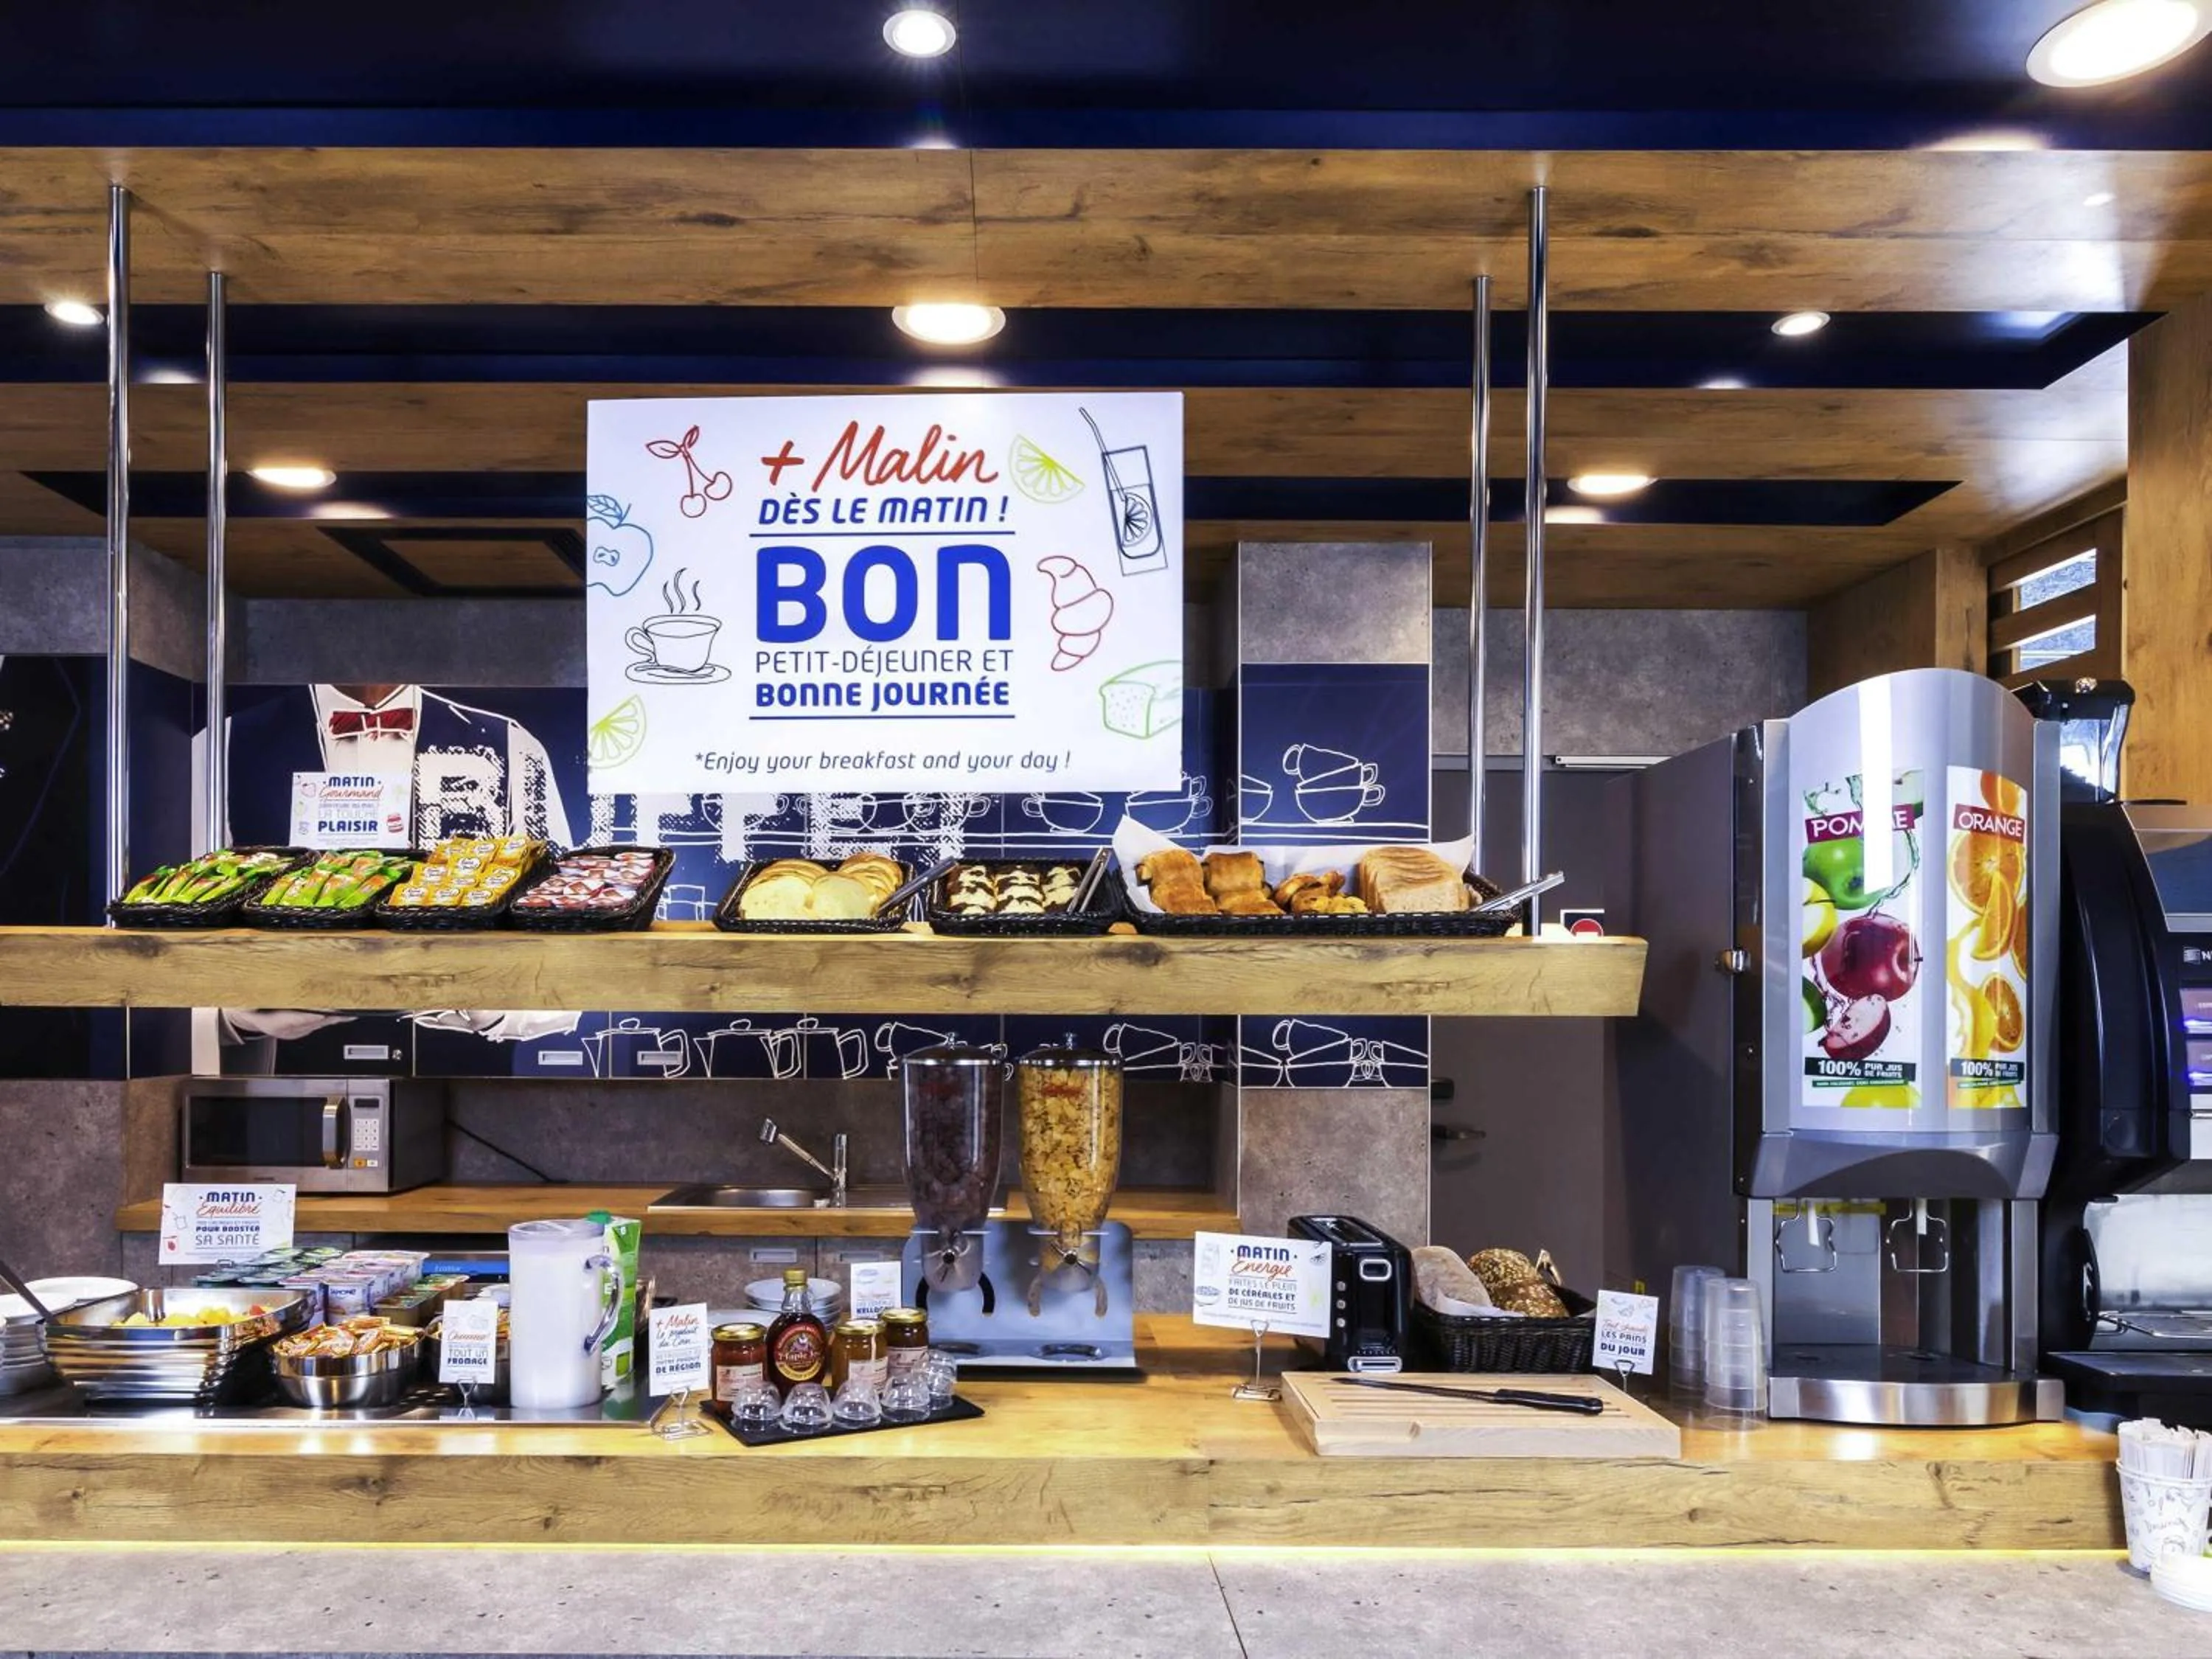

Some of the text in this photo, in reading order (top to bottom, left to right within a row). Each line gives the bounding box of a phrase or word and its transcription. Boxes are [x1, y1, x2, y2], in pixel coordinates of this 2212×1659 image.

[812, 420, 999, 491] Malin
[759, 493, 820, 525] DÈS
[832, 498, 866, 524] LE
[877, 497, 987, 524] MATIN
[756, 544, 1011, 643] BON
[756, 646, 1014, 677] PETIT-DÉJEUNER ET
[756, 676, 1009, 712] BONNE JOURNÉE
[767, 756, 813, 773] your
[819, 752, 913, 770] breakfast
[923, 752, 959, 770] and
[967, 754, 1014, 773] your
[1020, 751, 1060, 772] day
[328, 776, 375, 787] MATIN
[318, 821, 378, 832] PLAISIR
[1811, 810, 1907, 838] POME
[1958, 812, 2023, 838] ORANGE
[1818, 1060, 1862, 1077] 100%
[1961, 1061, 1993, 1077] 100%
[206, 1192, 255, 1202] MATIN
[195, 1232, 260, 1245] SA SANTÉ
[1237, 1245, 1290, 1262] MATIN
[1228, 1278, 1297, 1292] FAITES LE PLEIN
[1242, 1289, 1283, 1300] CÉRÉALES
[1285, 1293, 1295, 1301] ET
[1239, 1298, 1253, 1307] JUS
[1255, 1299, 1265, 1307] DE
[1267, 1301, 1295, 1311] FRUITS
[1601, 1330, 1646, 1343] LES PAINS
[448, 1349, 472, 1357] TOUT
[1601, 1343, 1646, 1356] DU JOUR
[669, 1362, 701, 1372] RÉGION
